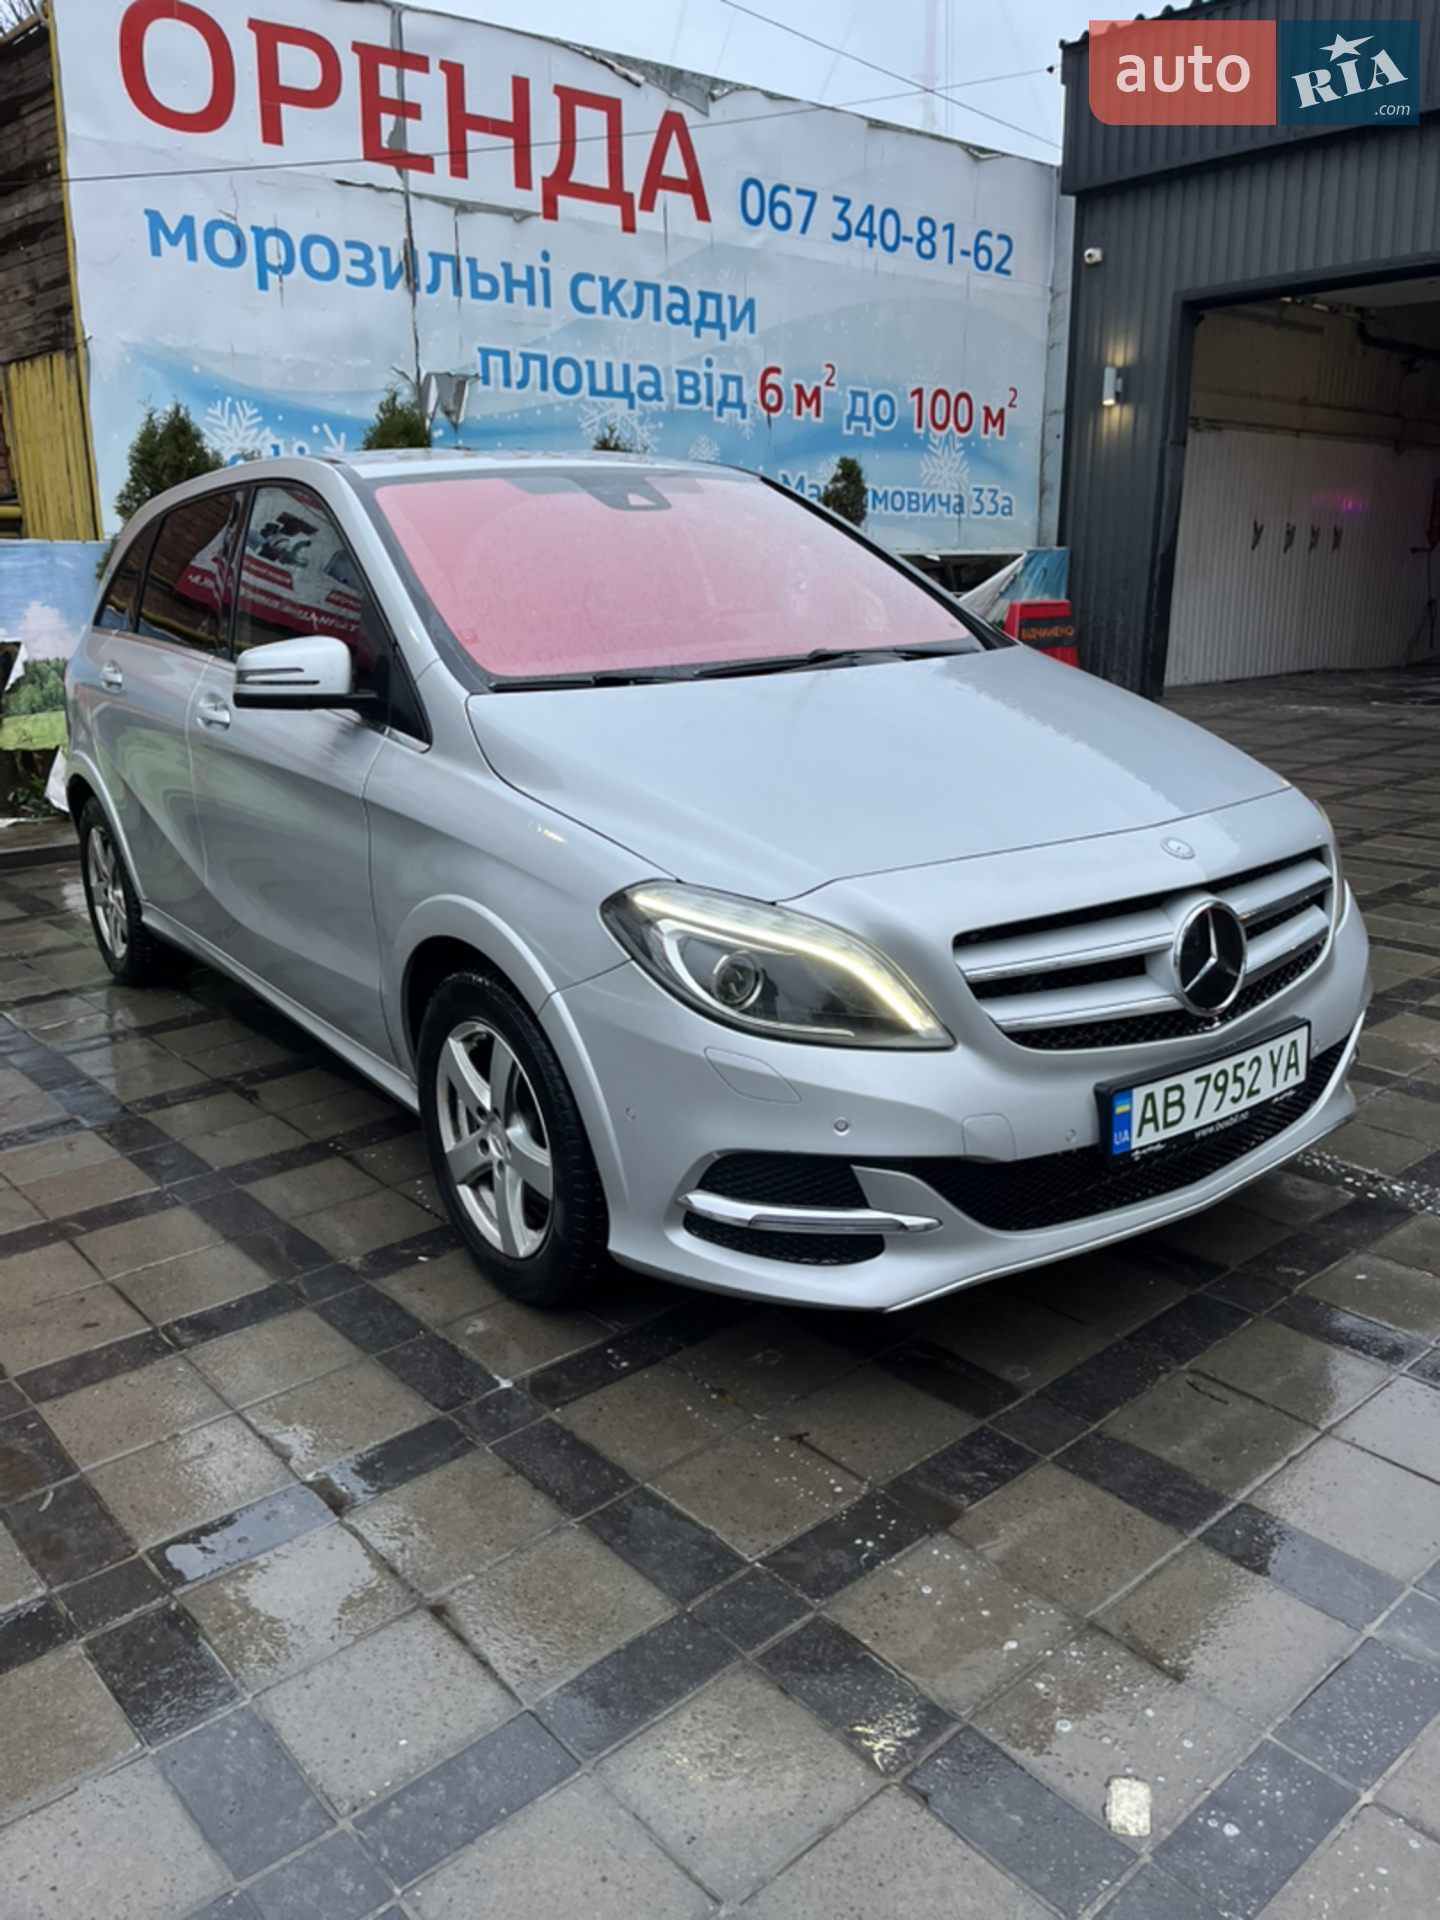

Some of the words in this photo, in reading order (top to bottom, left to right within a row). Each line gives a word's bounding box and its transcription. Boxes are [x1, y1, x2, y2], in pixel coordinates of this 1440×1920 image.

[118, 0, 712, 234] ОРЕНДА
[144, 208, 552, 308] морозильні
[569, 270, 757, 341] склади
[740, 177, 817, 235] 067
[831, 194, 1014, 276] 340-81-62
[477, 346, 664, 410] площа
[676, 357, 748, 420] від
[758, 366, 784, 414] 6
[845, 390, 896, 433] до
[910, 387, 974, 434] 100
[781, 473, 966, 515] Мамовича
[971, 487, 1014, 517] 33а
[1114, 1129, 1131, 1146] UA
[1137, 1083, 1186, 1139] AB
[1194, 1055, 1262, 1119] 7952
[1269, 1039, 1300, 1088] YA
